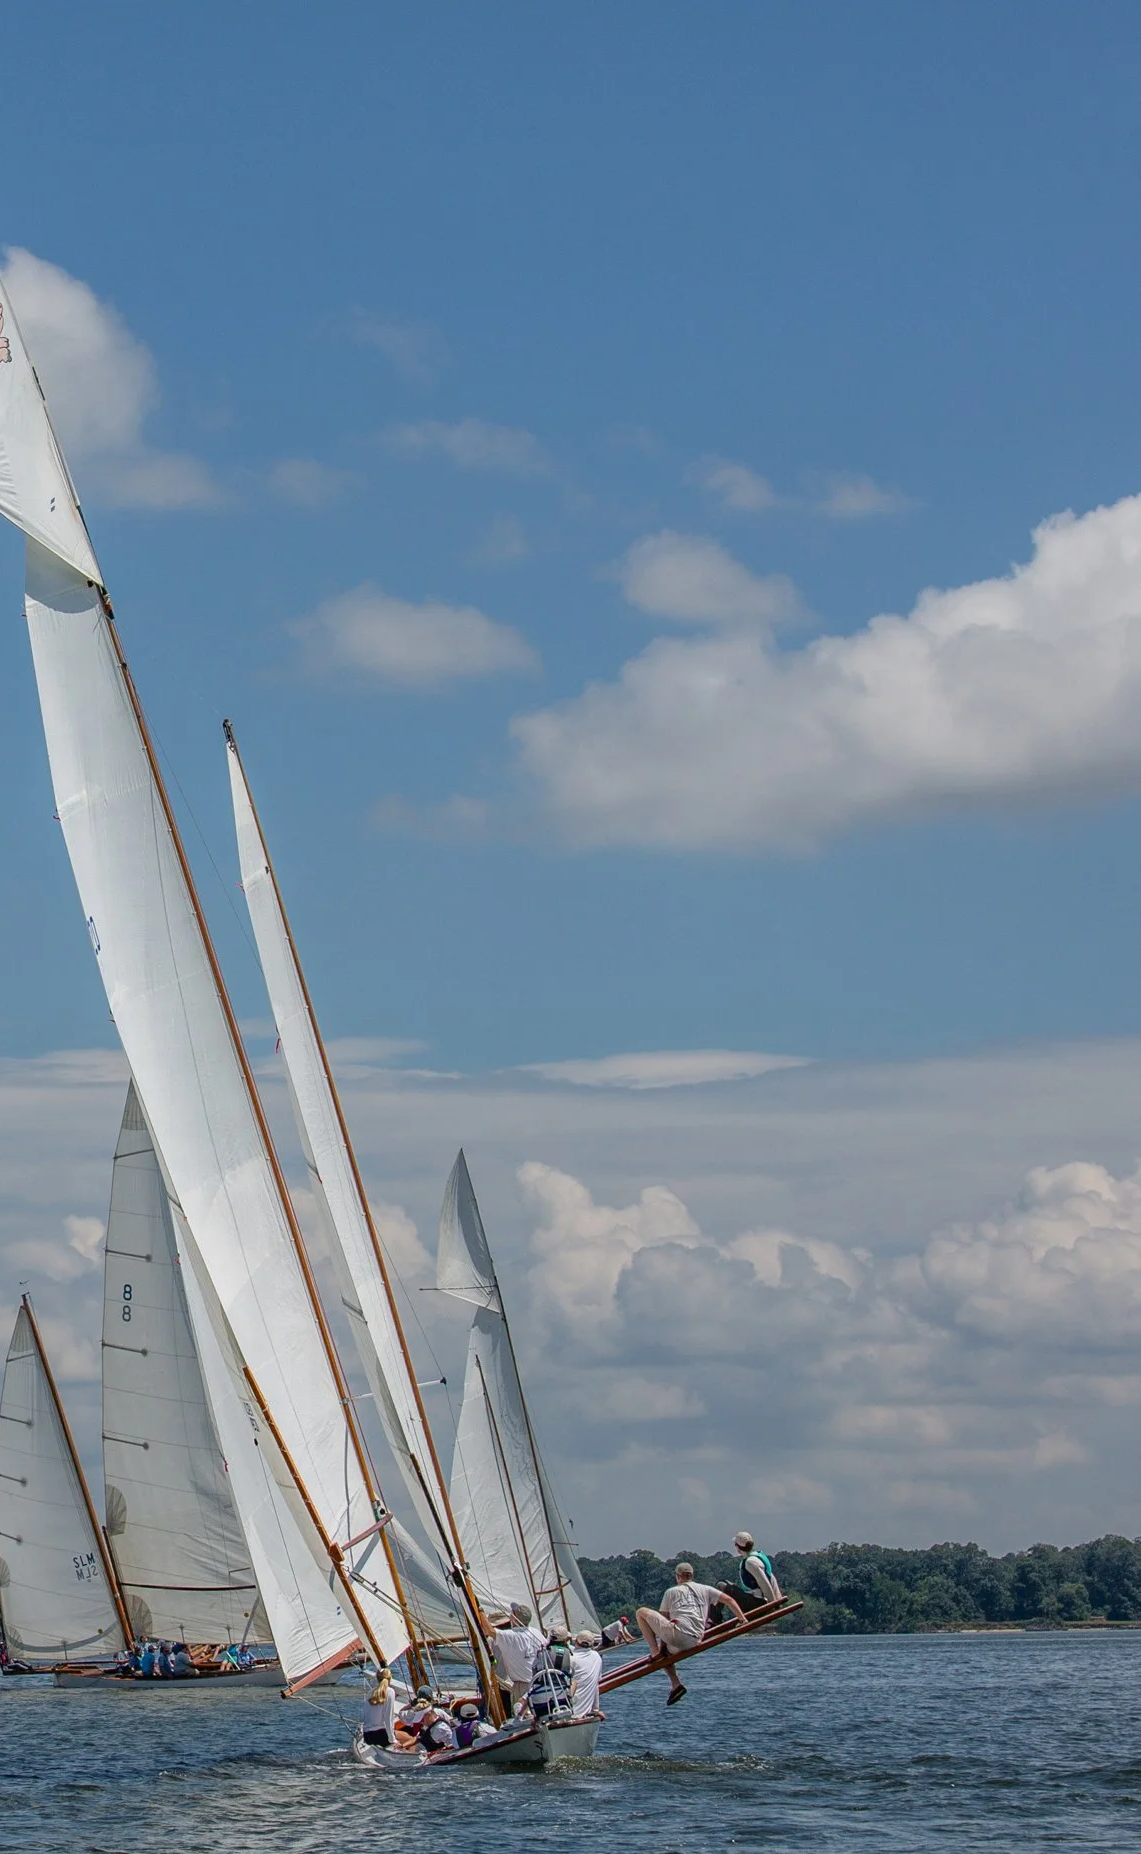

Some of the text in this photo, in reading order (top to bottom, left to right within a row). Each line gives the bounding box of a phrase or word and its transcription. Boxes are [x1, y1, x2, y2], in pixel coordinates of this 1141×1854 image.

[123, 1284, 132, 1301] 8
[122, 1305, 131, 1322] 8
[73, 1552, 96, 1568] SLM
